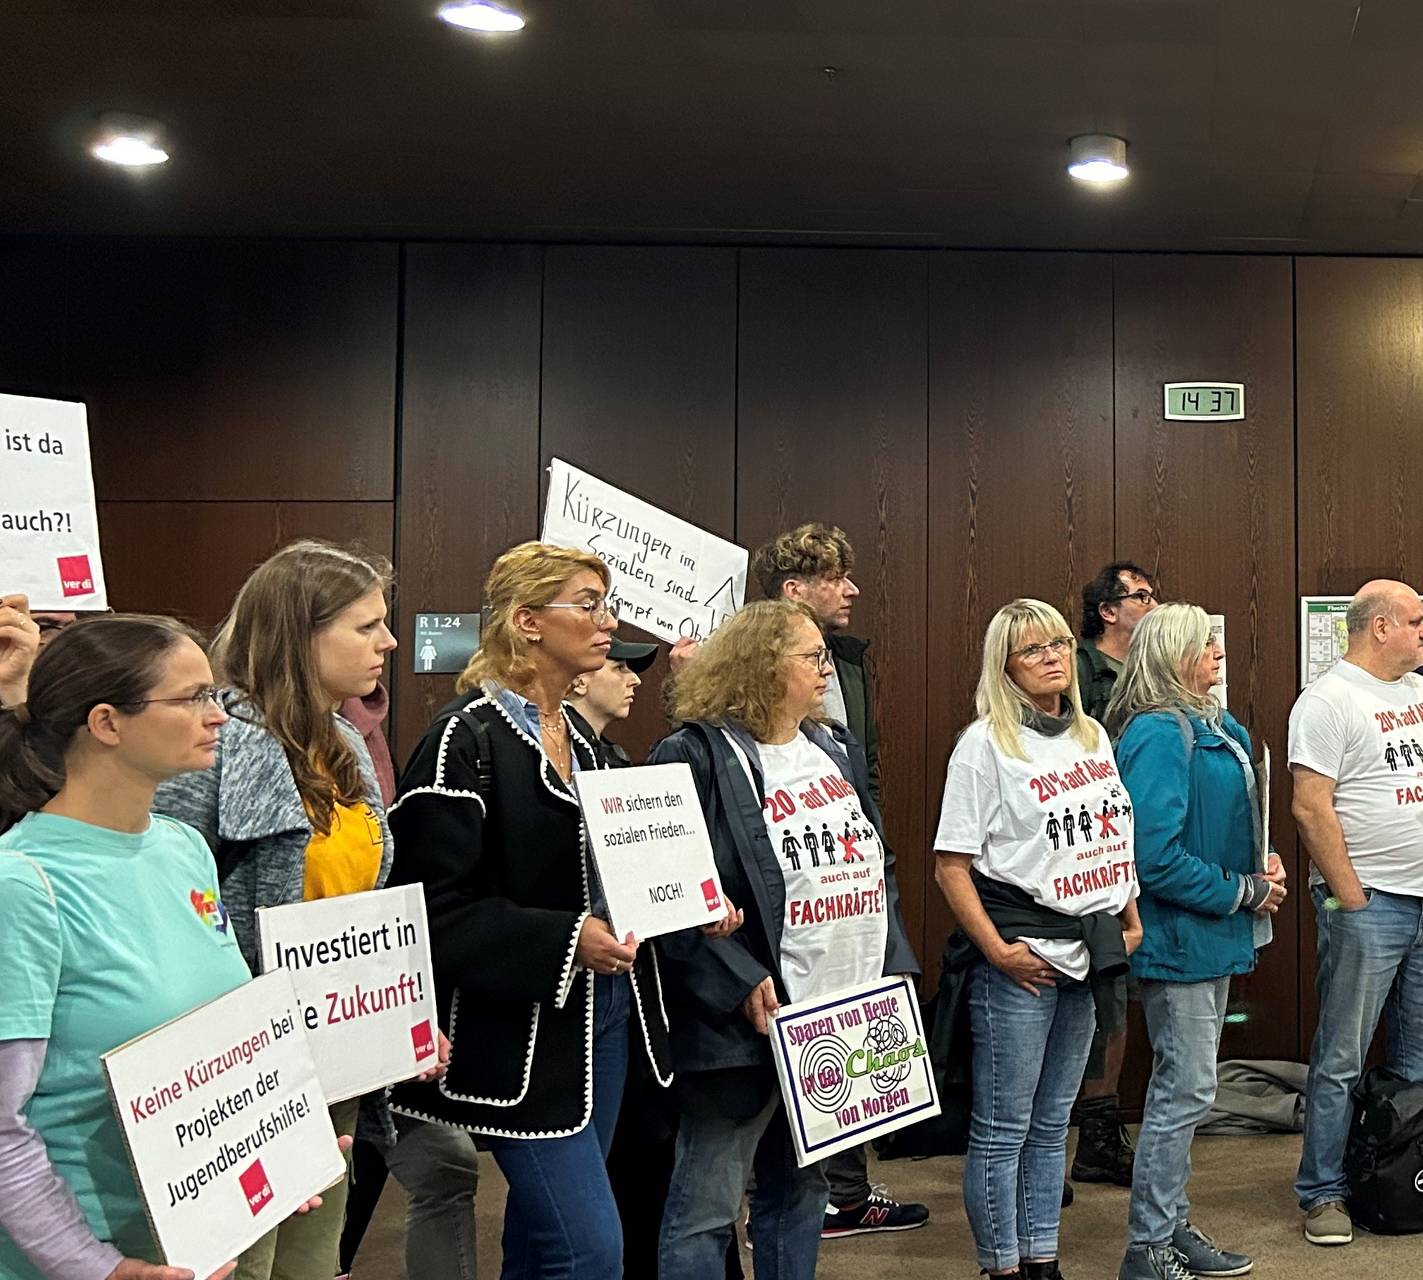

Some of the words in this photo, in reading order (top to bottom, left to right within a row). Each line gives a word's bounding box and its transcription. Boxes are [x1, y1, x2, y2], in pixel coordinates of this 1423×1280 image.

[1182, 392, 1199, 411] 14
[1210, 391, 1235, 412] 37
[5, 428, 32, 452] ist
[38, 432, 64, 455] da
[1, 510, 72, 533] auch?!
[679, 552, 696, 571] im
[420, 616, 429, 628] R
[433, 616, 461, 628] 1.24
[1064, 762, 1091, 789] auf
[601, 797, 625, 814] WIR
[626, 793, 663, 812] sichern
[664, 791, 683, 807] den
[798, 782, 829, 810] auf
[604, 826, 648, 847] sozialen
[1076, 846, 1104, 861] auch
[1106, 840, 1128, 853] auf
[820, 871, 850, 884] auch
[852, 868, 871, 880] auf
[649, 882, 684, 904] NOCH!
[790, 879, 884, 926] FACHKRÄFTE?
[275, 923, 391, 970] Investiert
[396, 917, 416, 947] in
[325, 972, 424, 1025] Zukunft!
[787, 1016, 836, 1046] Sparen
[862, 995, 899, 1022] Heute
[130, 1081, 183, 1123] Keine
[184, 1029, 270, 1092] Kürzungen
[271, 1009, 295, 1040] bei
[845, 1038, 927, 1079] Chaos
[175, 1087, 254, 1148] Projekten
[256, 1069, 281, 1098] der
[861, 1087, 911, 1120] Morgen
[168, 1093, 310, 1207] Jugendberufshilfe!
